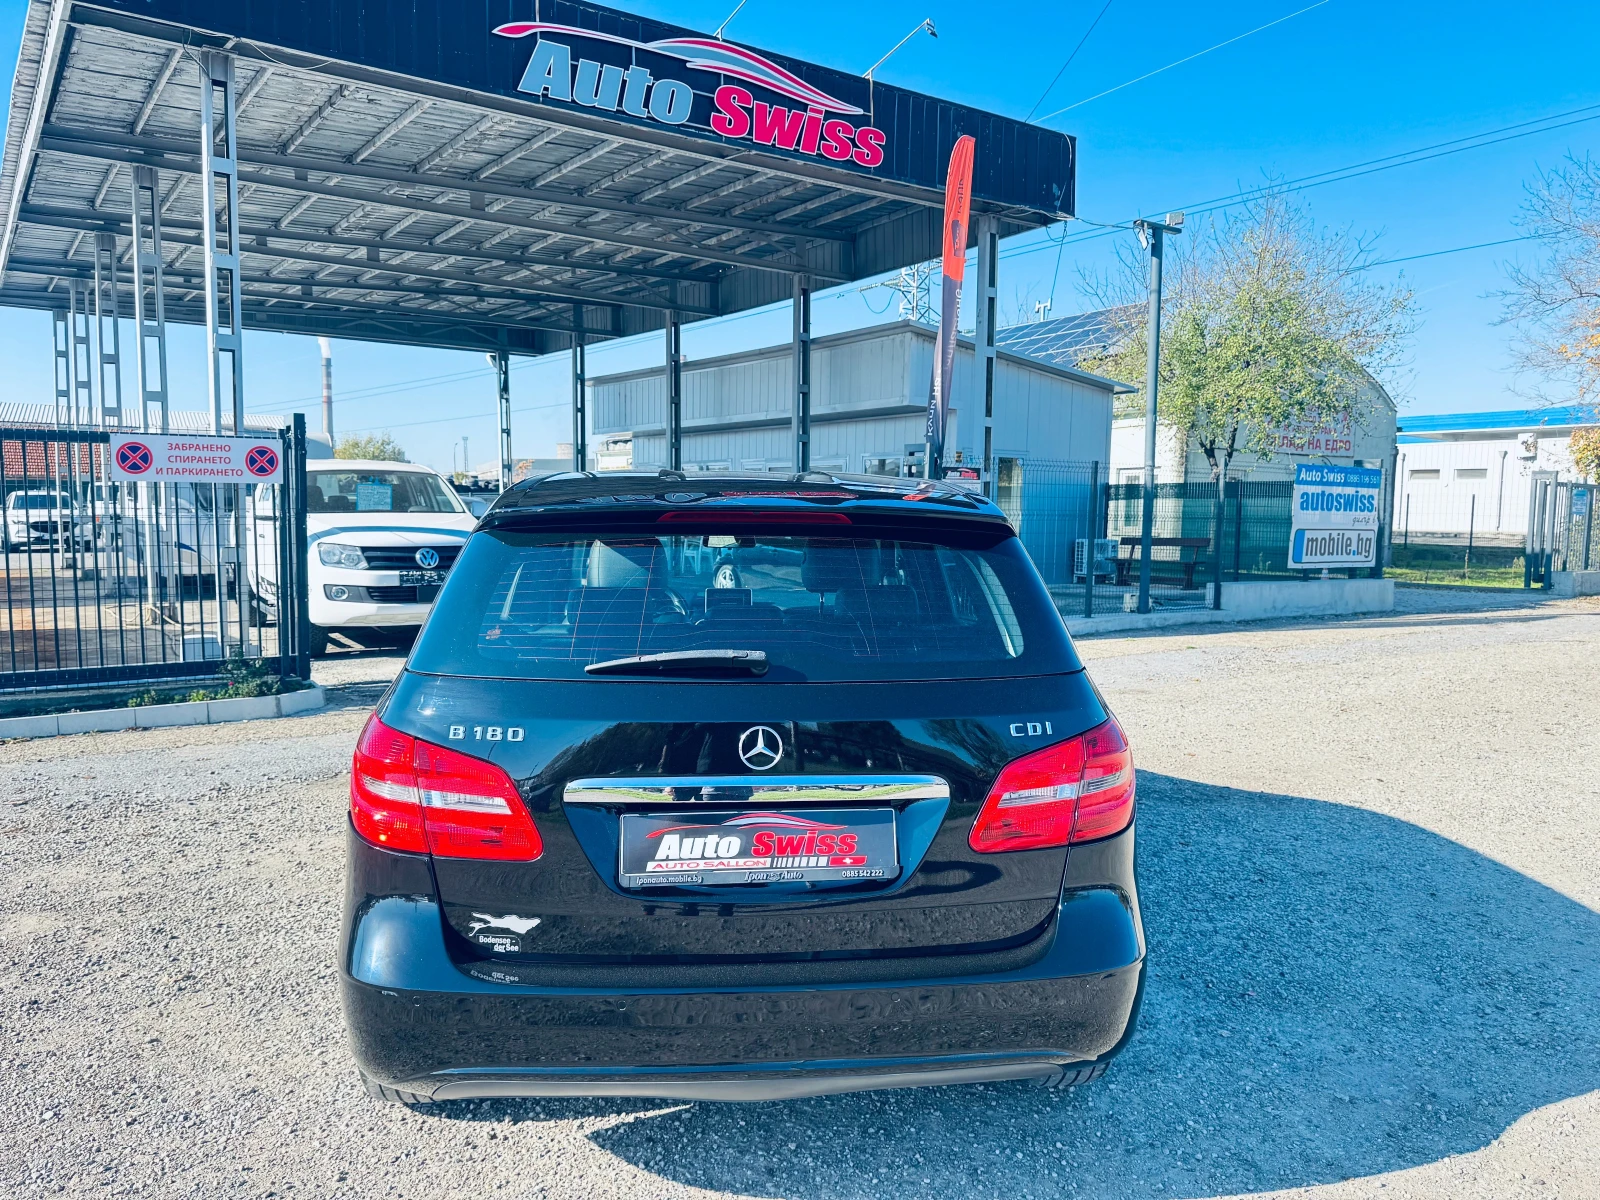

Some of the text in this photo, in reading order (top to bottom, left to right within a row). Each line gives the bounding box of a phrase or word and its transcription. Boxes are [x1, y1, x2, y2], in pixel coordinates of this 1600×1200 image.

[517, 39, 886, 168] Auto Swiss
[167, 442, 231, 452] ЗАБРАНЕНО
[1307, 437, 1321, 450] НА
[1325, 439, 1351, 453] ЕДРО
[167, 455, 231, 464] СПИРАНЕТО
[155, 467, 243, 477] И ПАРКИРАНЕТО
[1300, 468, 1321, 482] Auto
[1323, 469, 1345, 483] Swiss
[1304, 533, 1372, 558] mobile.bg
[449, 725, 525, 742] B 180
[1009, 721, 1053, 737] CDI
[655, 830, 858, 860] Auto Swiss
[652, 859, 768, 870] AUTO SALLON
[842, 870, 859, 878] 0885
[859, 869, 871, 877] 542
[479, 935, 511, 943] Bodensee
[493, 943, 506, 952] der
